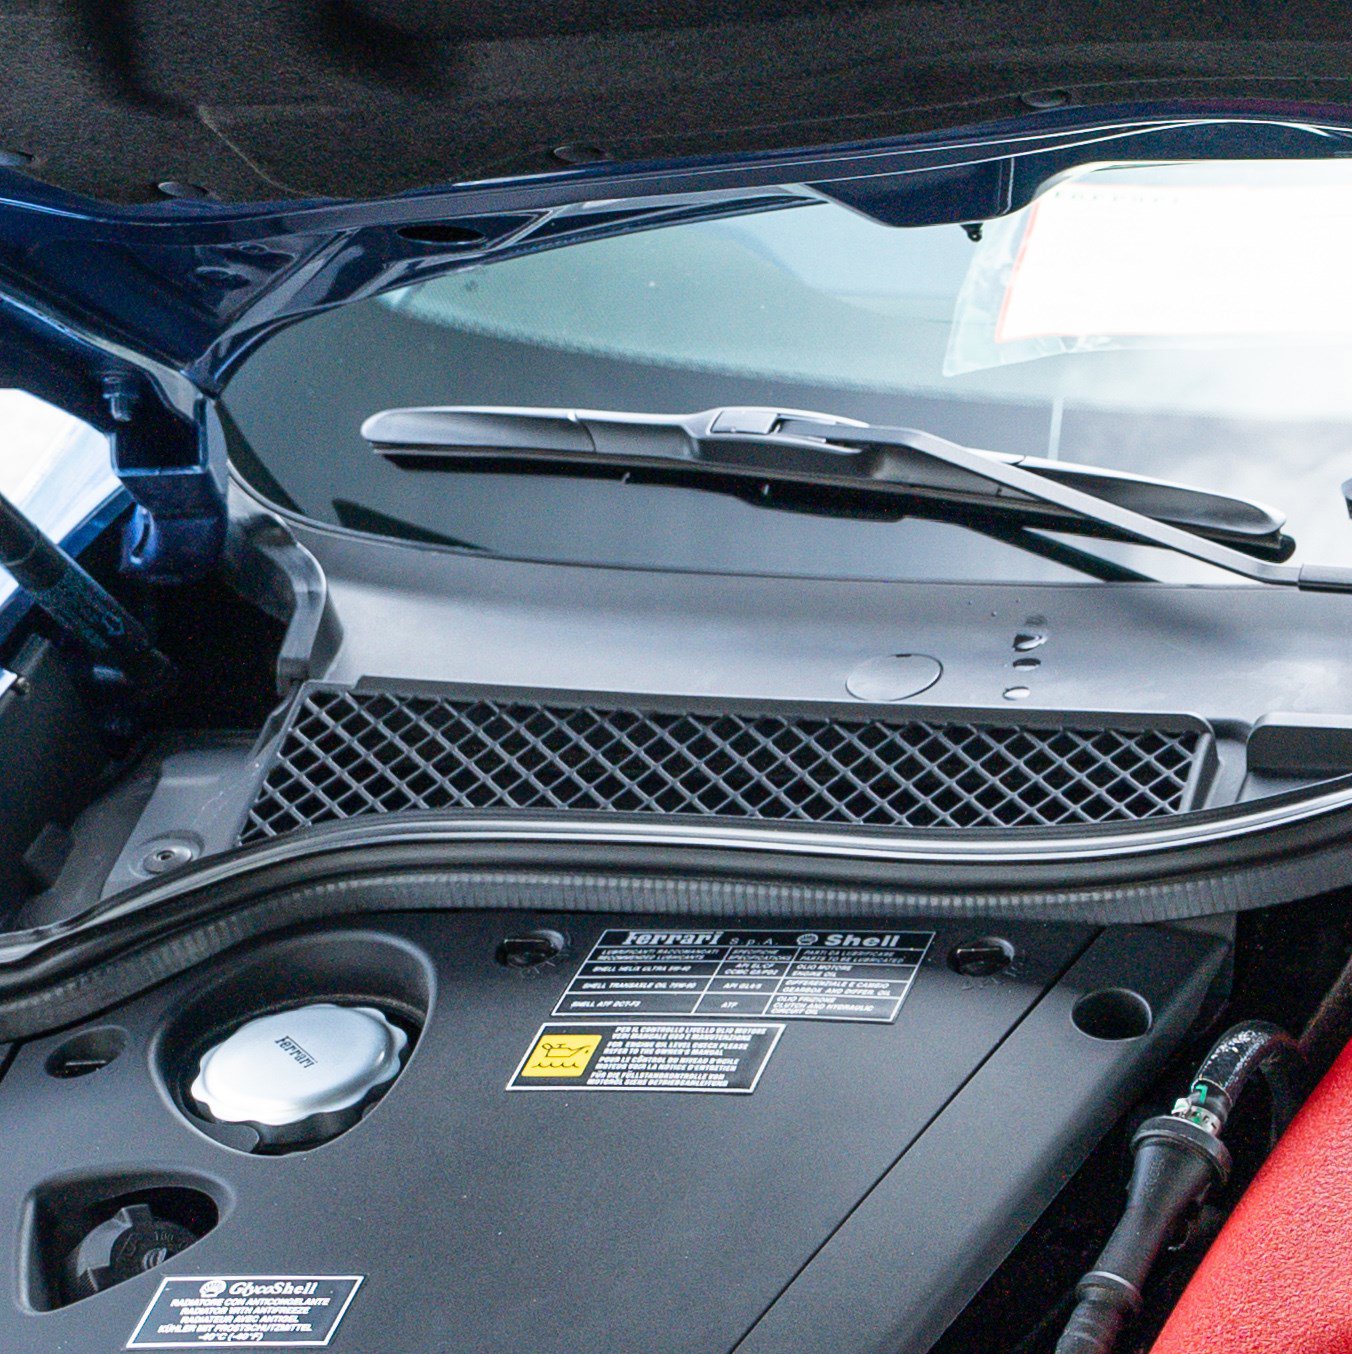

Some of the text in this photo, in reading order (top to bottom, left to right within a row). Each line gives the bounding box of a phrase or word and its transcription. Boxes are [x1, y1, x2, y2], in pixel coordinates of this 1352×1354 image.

[622, 931, 724, 945] Ferrari
[825, 934, 900, 947] Shell
[275, 1035, 318, 1069] Ferrari
[229, 1282, 318, 1296] GlycoShell
